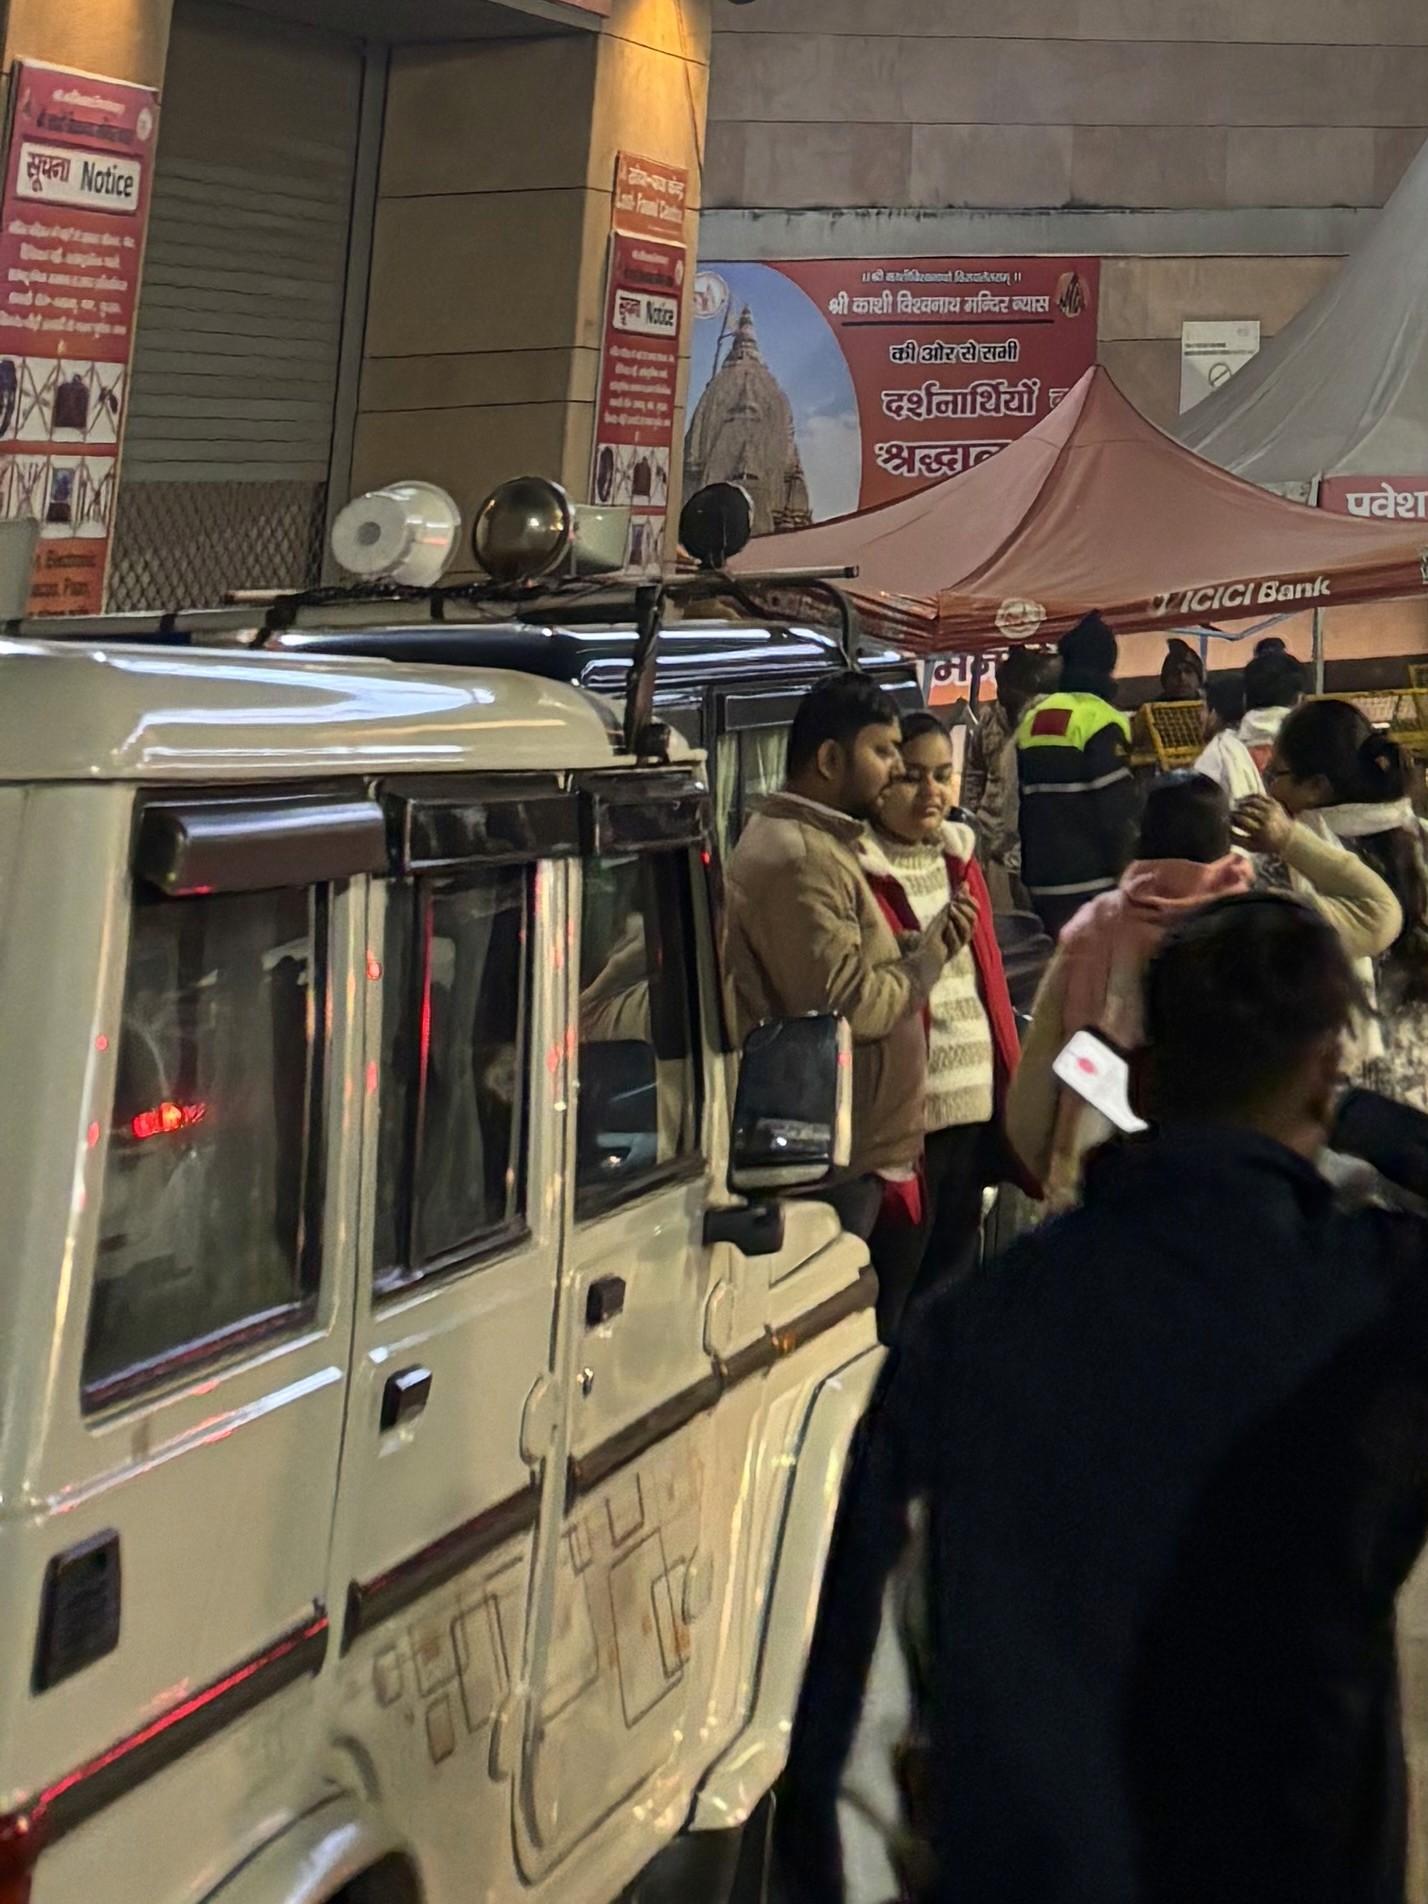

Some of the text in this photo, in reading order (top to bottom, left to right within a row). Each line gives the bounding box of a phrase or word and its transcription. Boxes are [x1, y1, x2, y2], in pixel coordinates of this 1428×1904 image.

[26, 151, 71, 192] सूचना
[80, 160, 134, 198] Notice
[828, 289, 1050, 315] श्री काशी विश्वनाथ मन्दिर न्यास
[890, 338, 1019, 363] की ओर से सभी
[881, 378, 1040, 420] दर्शनार्थियों
[1180, 576, 1331, 614] ICICI Bank
